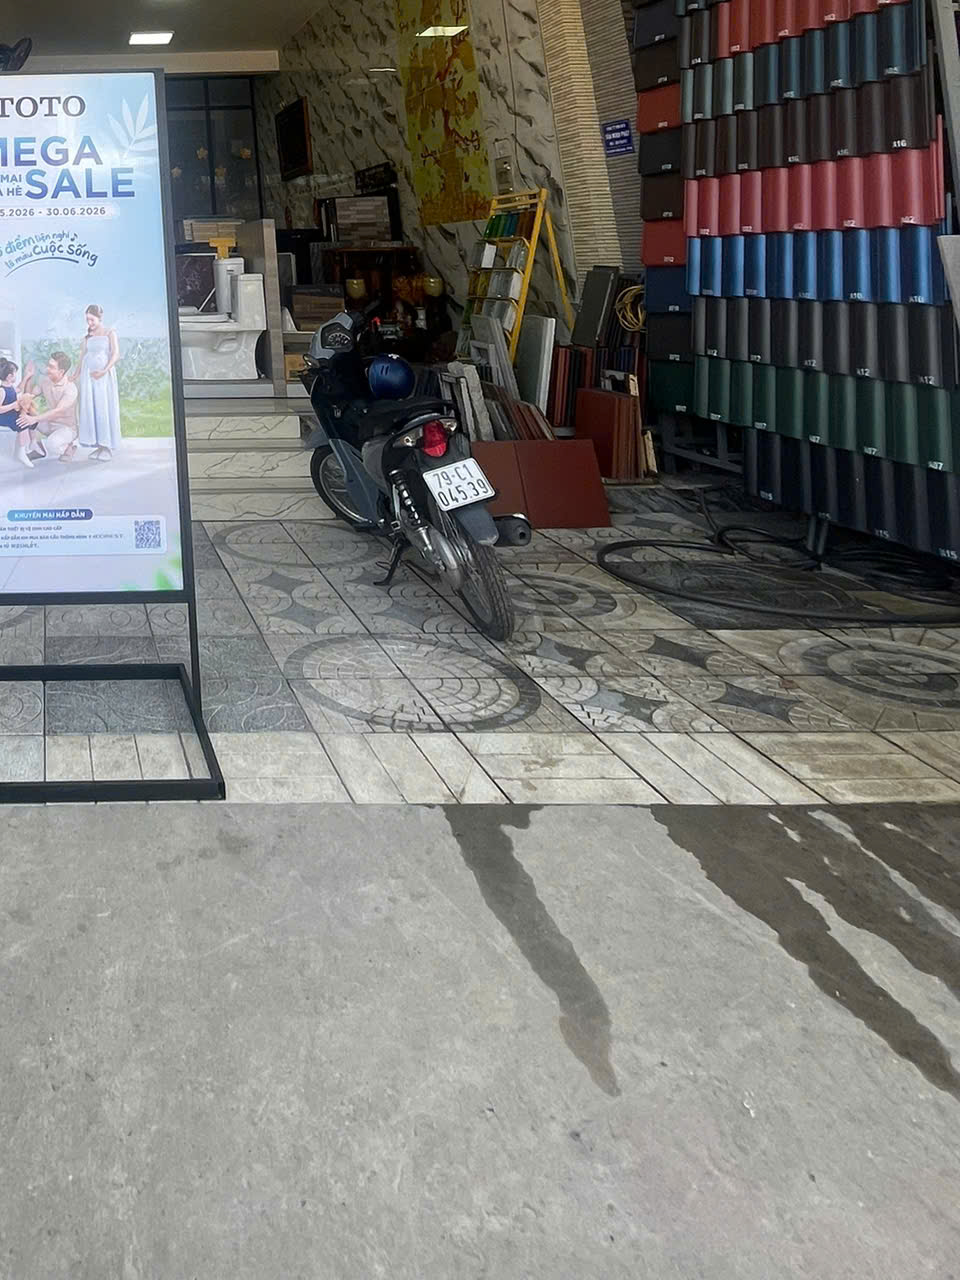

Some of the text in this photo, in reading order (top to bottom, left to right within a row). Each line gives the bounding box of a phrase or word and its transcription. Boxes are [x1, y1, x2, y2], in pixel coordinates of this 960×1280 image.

[0, 174, 22, 186] MẠI
[25, 167, 136, 199] SALE
[6, 185, 23, 197] HÈ
[46, 206, 107, 217] 30.06.2026
[432, 462, 475, 489] 79-C1
[437, 478, 489, 507] 045.39
